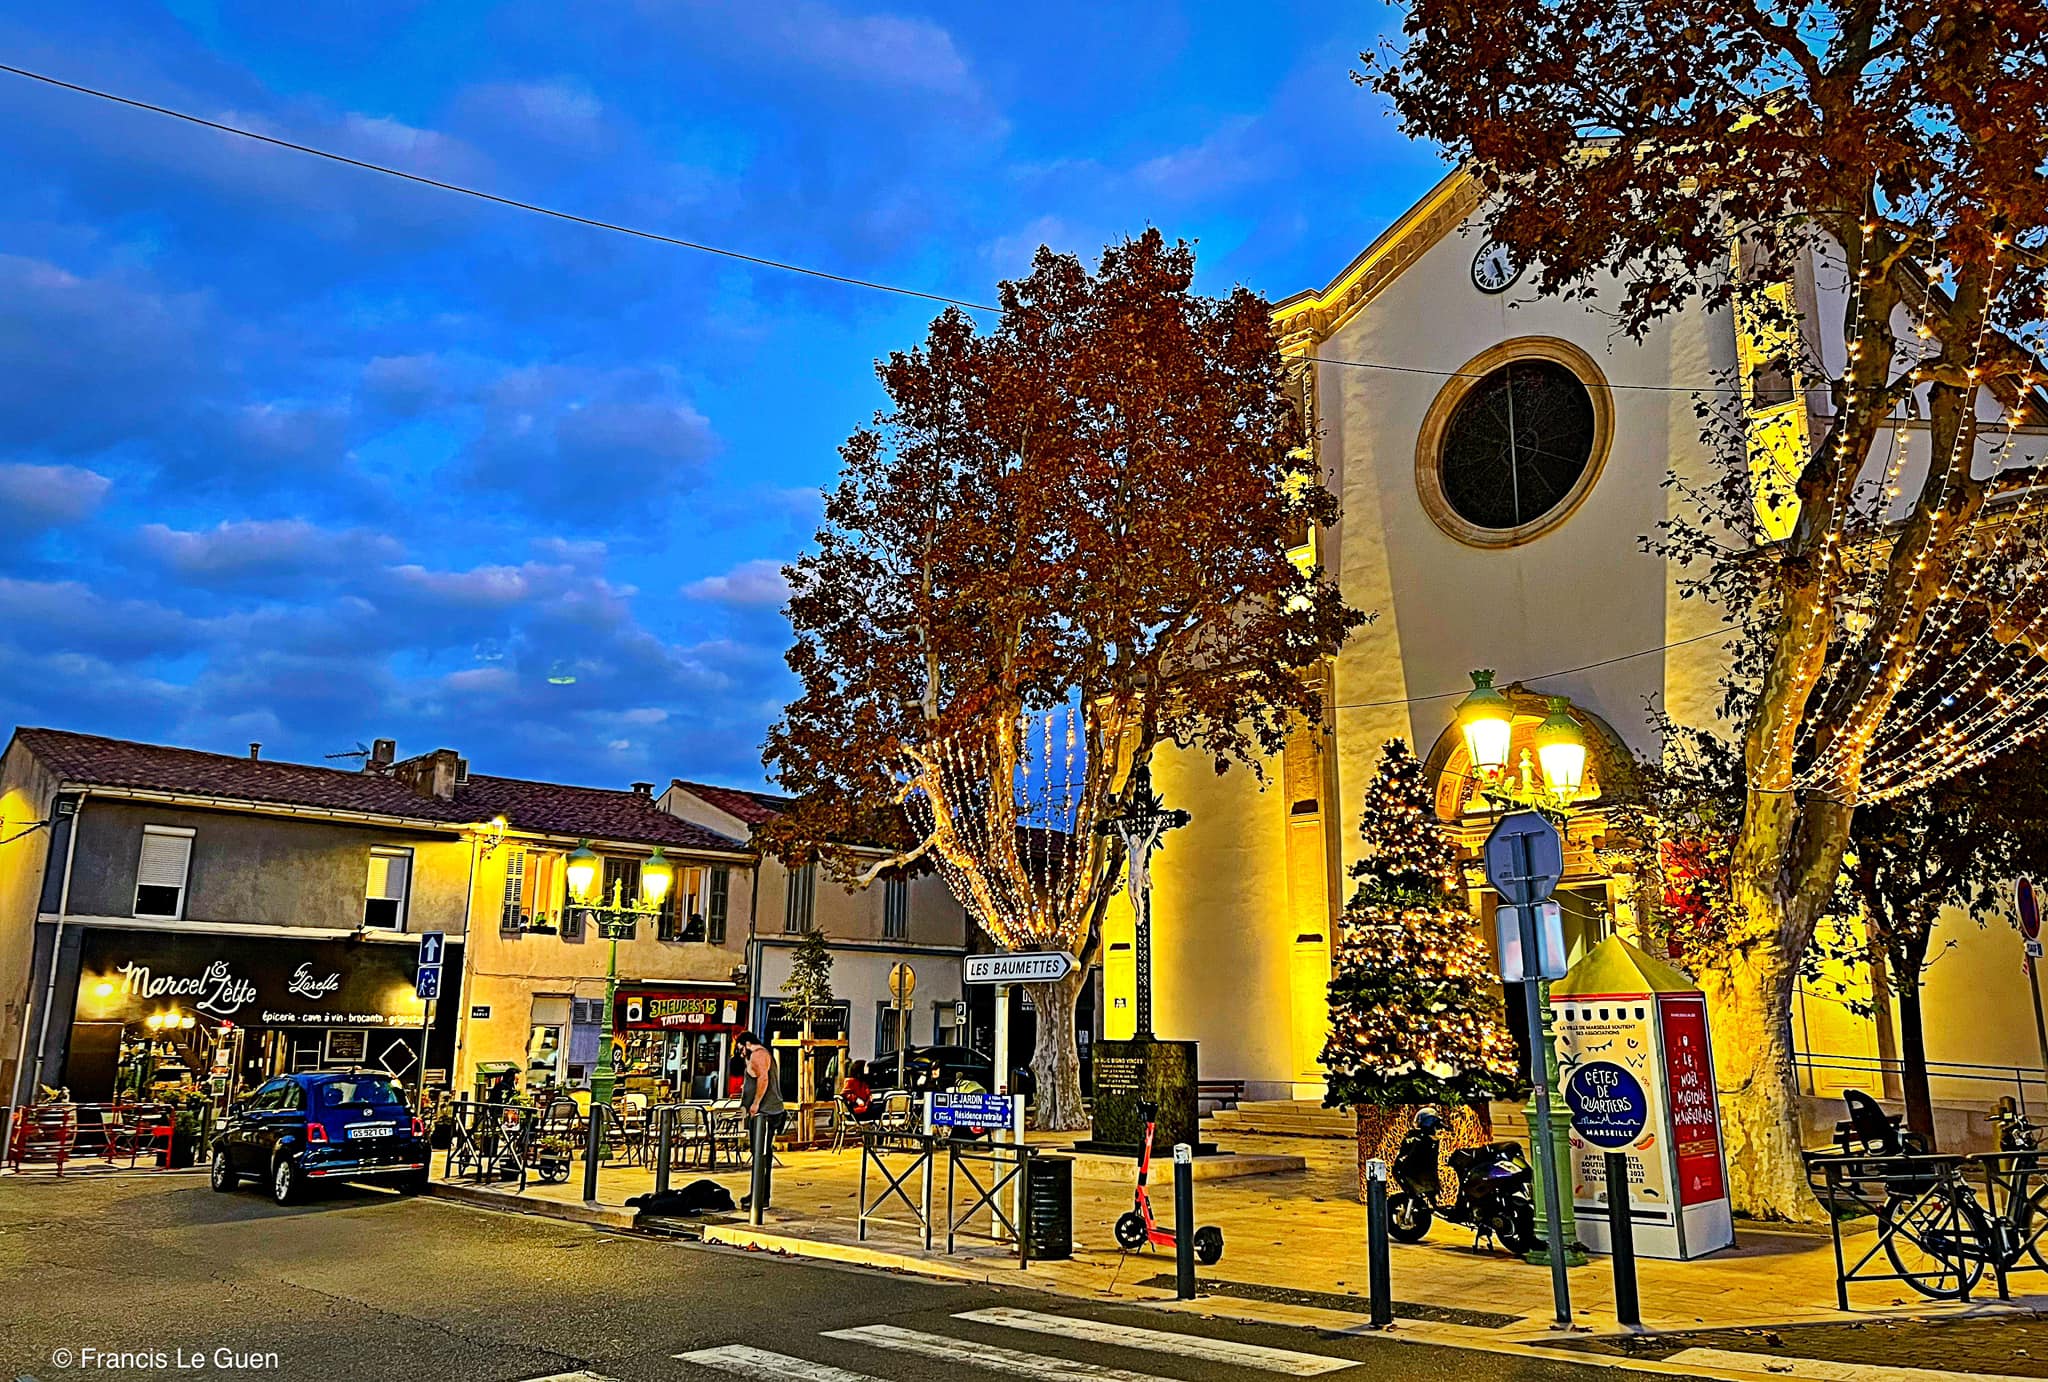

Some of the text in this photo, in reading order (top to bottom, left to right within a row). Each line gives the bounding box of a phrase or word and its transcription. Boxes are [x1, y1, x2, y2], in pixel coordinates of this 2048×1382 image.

[288, 962, 312, 986] by
[971, 960, 1060, 976] LES BAUMETTES
[117, 960, 211, 998] Marcel
[211, 960, 229, 977] &
[661, 1014, 705, 1027] TATTOO CLUB
[1585, 1068, 1619, 1086] FÊTES
[1680, 1070, 1698, 1087] NOËL
[950, 1094, 959, 1104] LE
[959, 1094, 983, 1105] JARDIN
[1597, 1085, 1610, 1098] DE
[1677, 1089, 1708, 1107] MAGIQUE
[1580, 1096, 1632, 1114] QUARTIERS
[954, 1110, 1003, 1121] Résidence retraite
[1586, 1129, 1633, 1137] MARSEILLE
